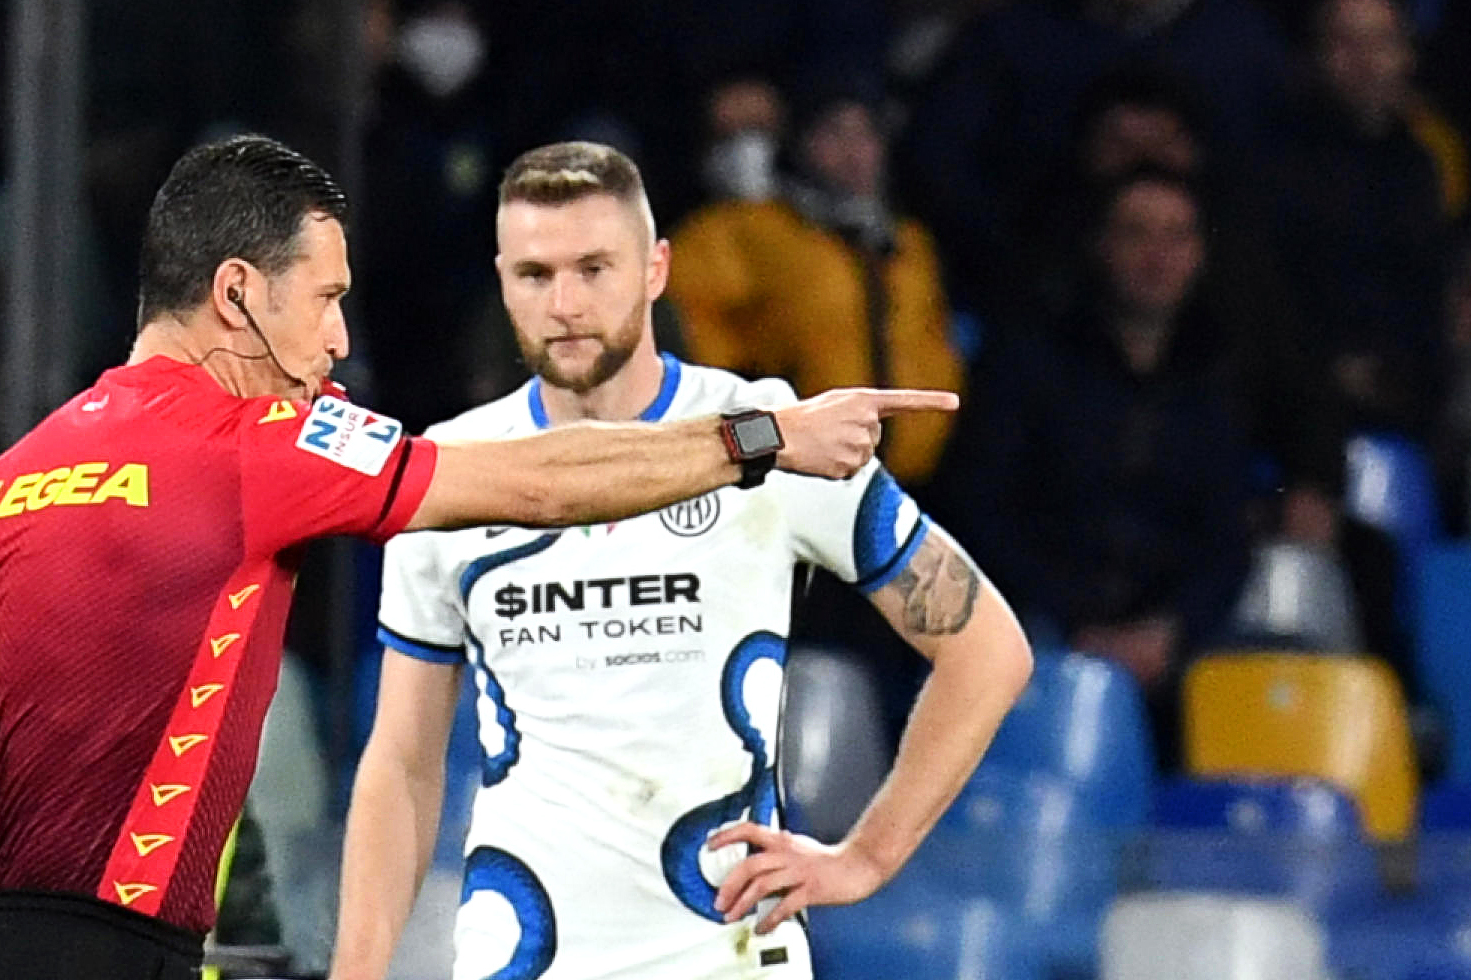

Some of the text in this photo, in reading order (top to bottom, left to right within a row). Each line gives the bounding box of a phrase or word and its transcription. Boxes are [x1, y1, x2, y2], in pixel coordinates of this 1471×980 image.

[494, 572, 702, 621] $INTER
[499, 614, 703, 648] FAN TOKEN
